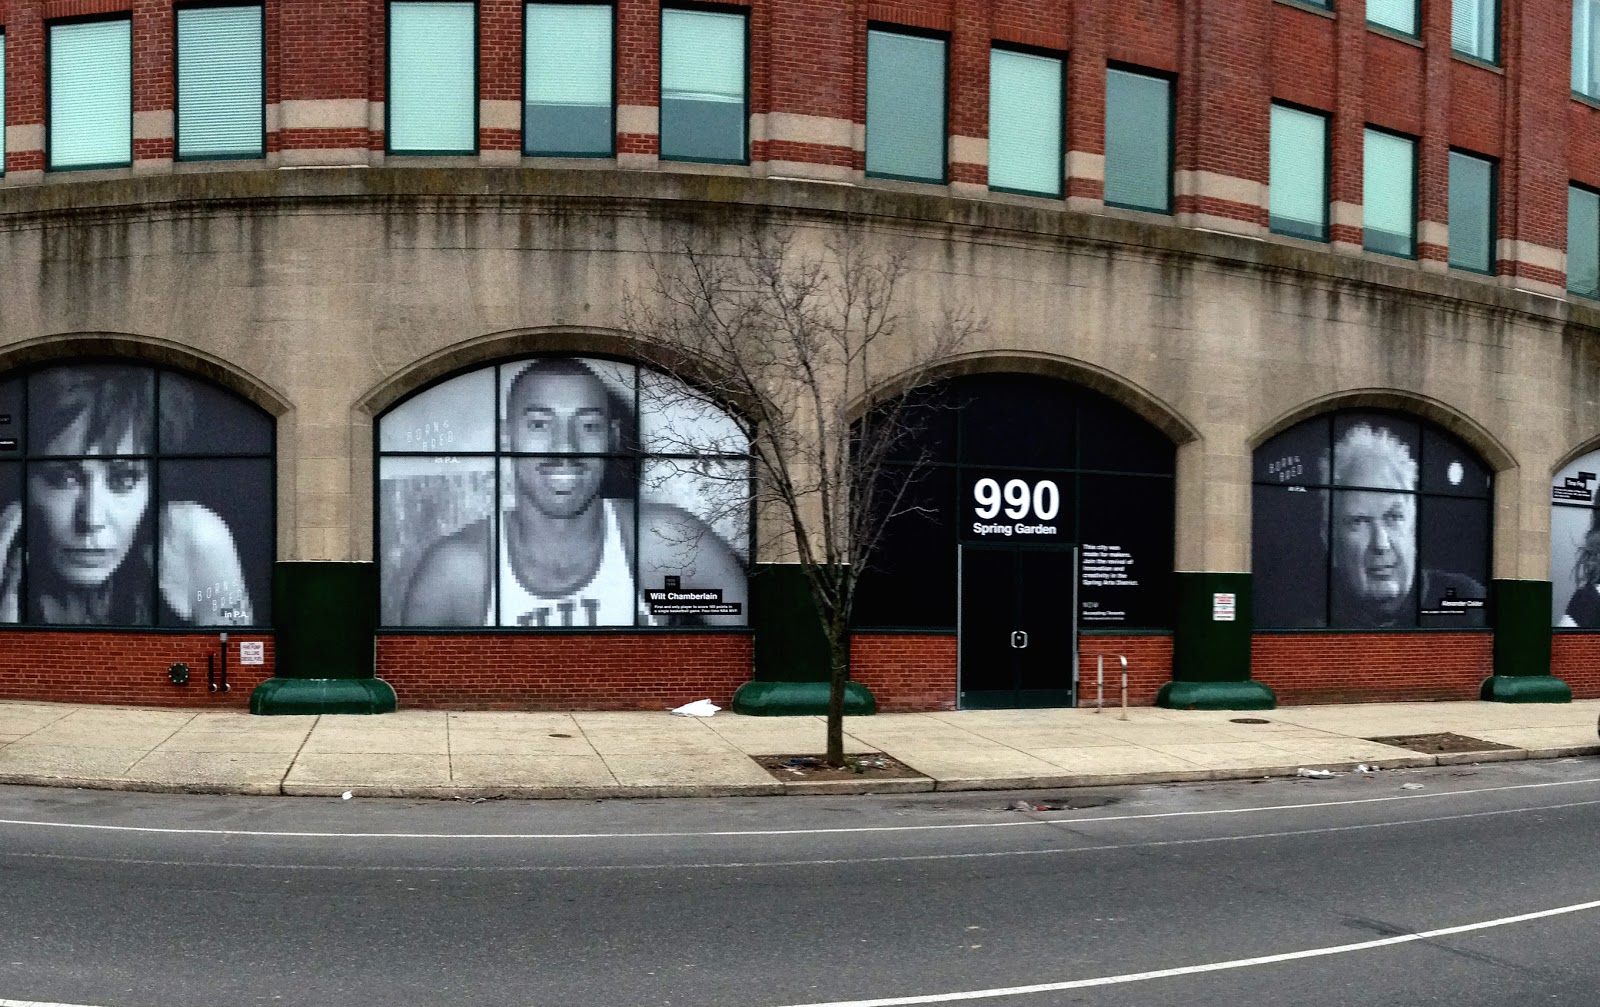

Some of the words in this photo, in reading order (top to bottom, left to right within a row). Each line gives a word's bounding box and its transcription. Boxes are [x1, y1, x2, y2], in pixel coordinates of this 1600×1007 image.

[973, 478, 1060, 520] 990
[973, 522, 1013, 537] Spring
[1014, 523, 1057, 535] Garden
[650, 592, 667, 600] Wilt
[667, 592, 718, 600] Chamberlain
[224, 610, 233, 618] in
